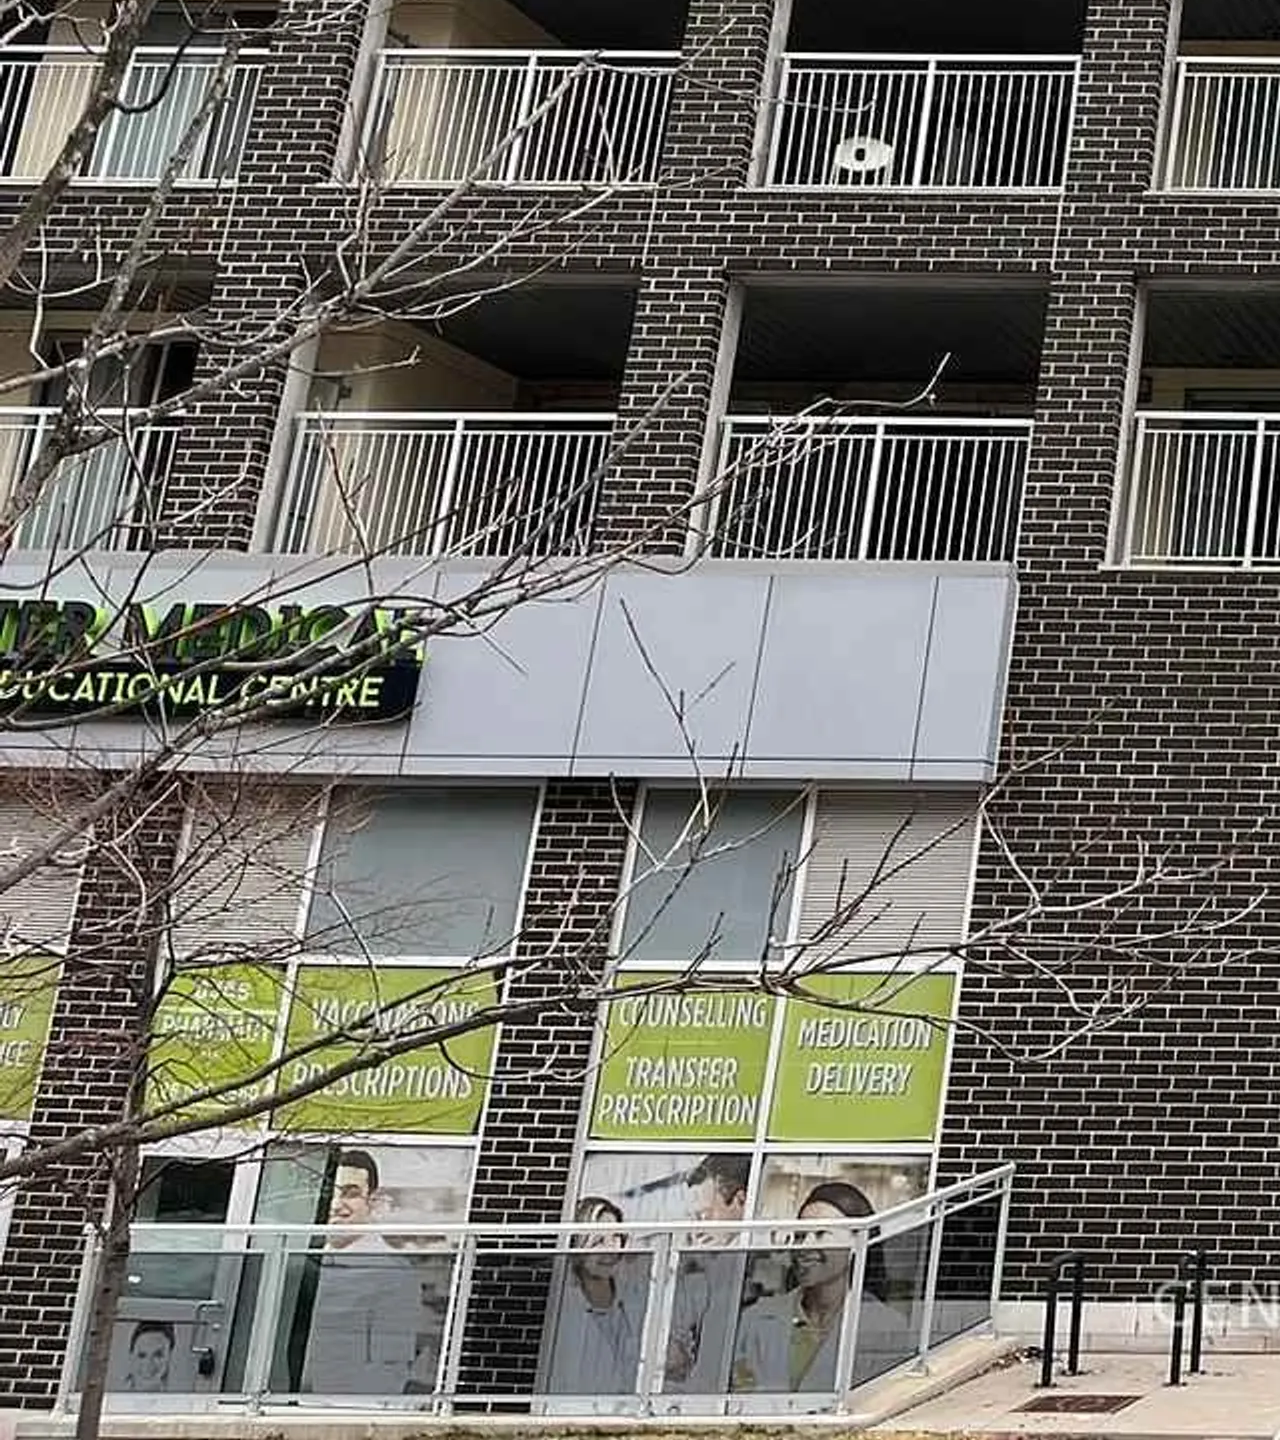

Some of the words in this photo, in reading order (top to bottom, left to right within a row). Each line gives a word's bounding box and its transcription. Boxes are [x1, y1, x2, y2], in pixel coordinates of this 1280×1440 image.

[240, 674, 385, 706] CENTRE
[620, 994, 768, 1029] COUNSELLING
[797, 1017, 933, 1050] MEDICATION
[626, 1056, 738, 1090] TRANSFER
[806, 1062, 913, 1094] DELIVERY
[598, 1093, 758, 1127] PRESCRIPTION
